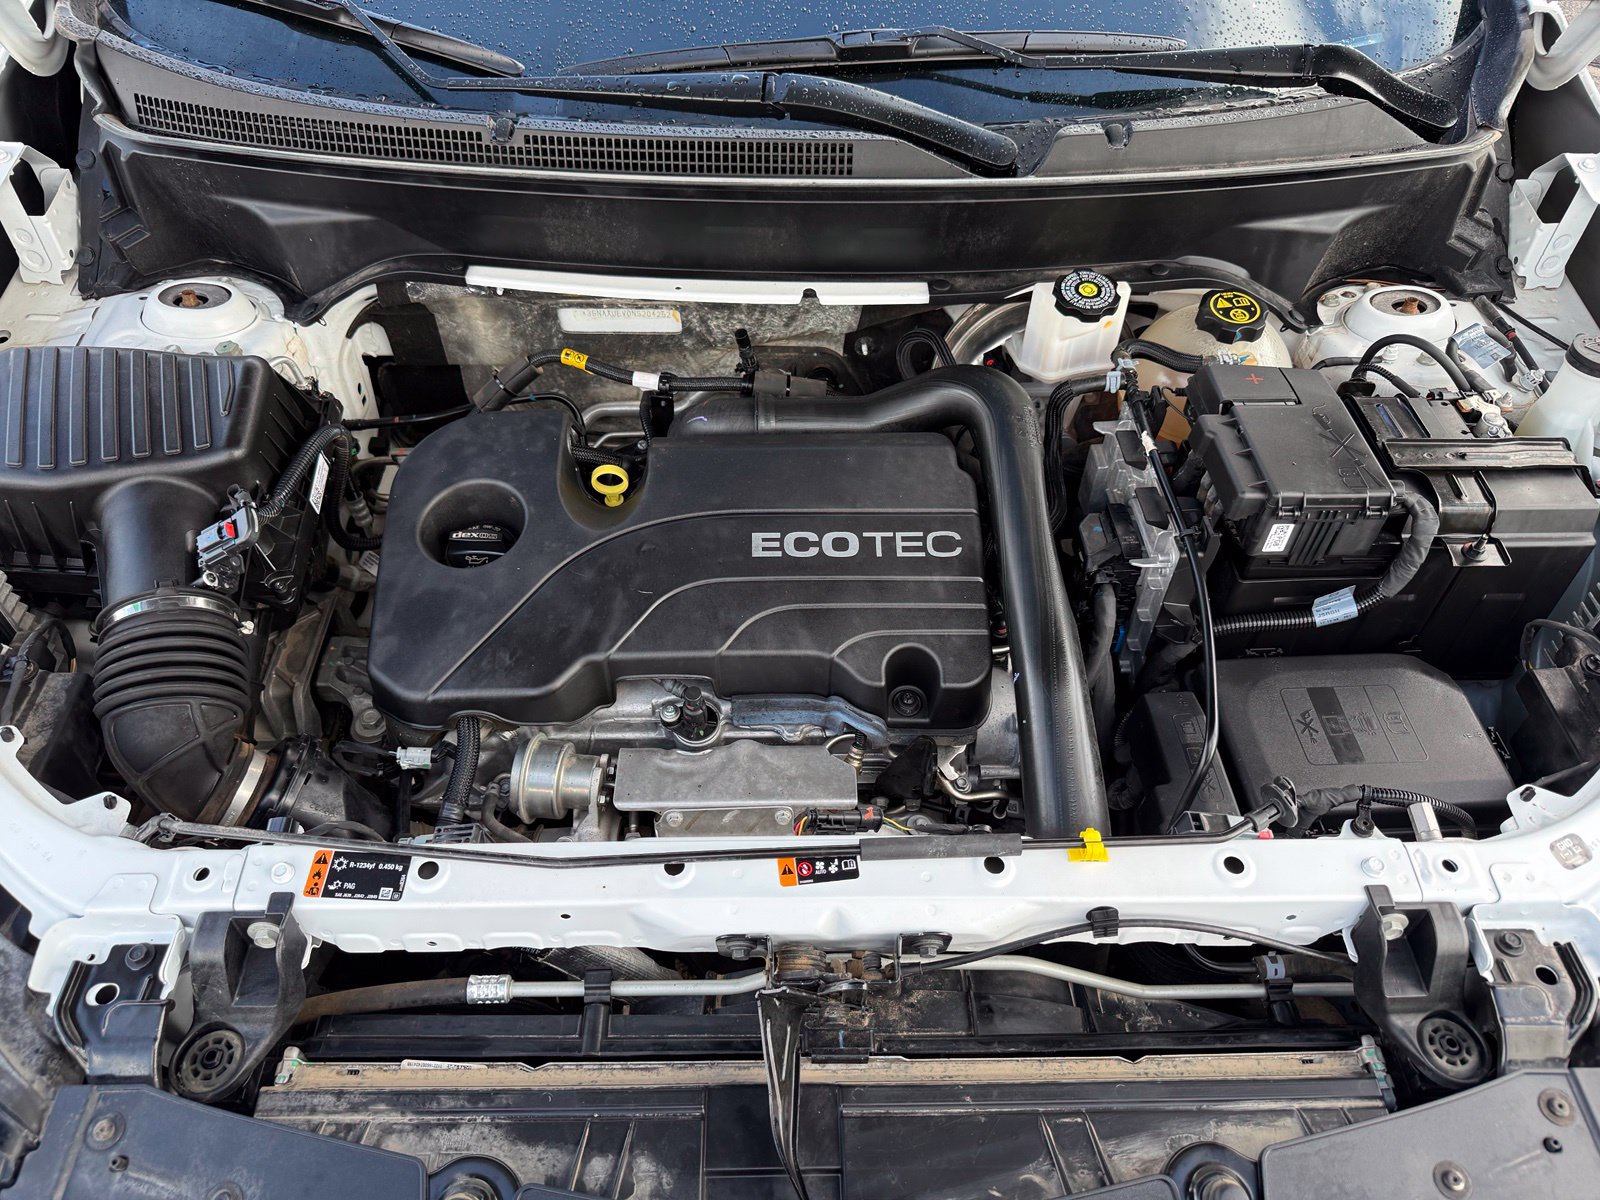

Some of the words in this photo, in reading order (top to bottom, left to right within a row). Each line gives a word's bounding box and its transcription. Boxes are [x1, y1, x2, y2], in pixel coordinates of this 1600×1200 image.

[452, 531, 498, 539] dexos
[751, 531, 963, 557] ECOTEC
[349, 861, 376, 870] R-1234yf
[395, 864, 404, 872] kg
[343, 882, 356, 890] PAG
